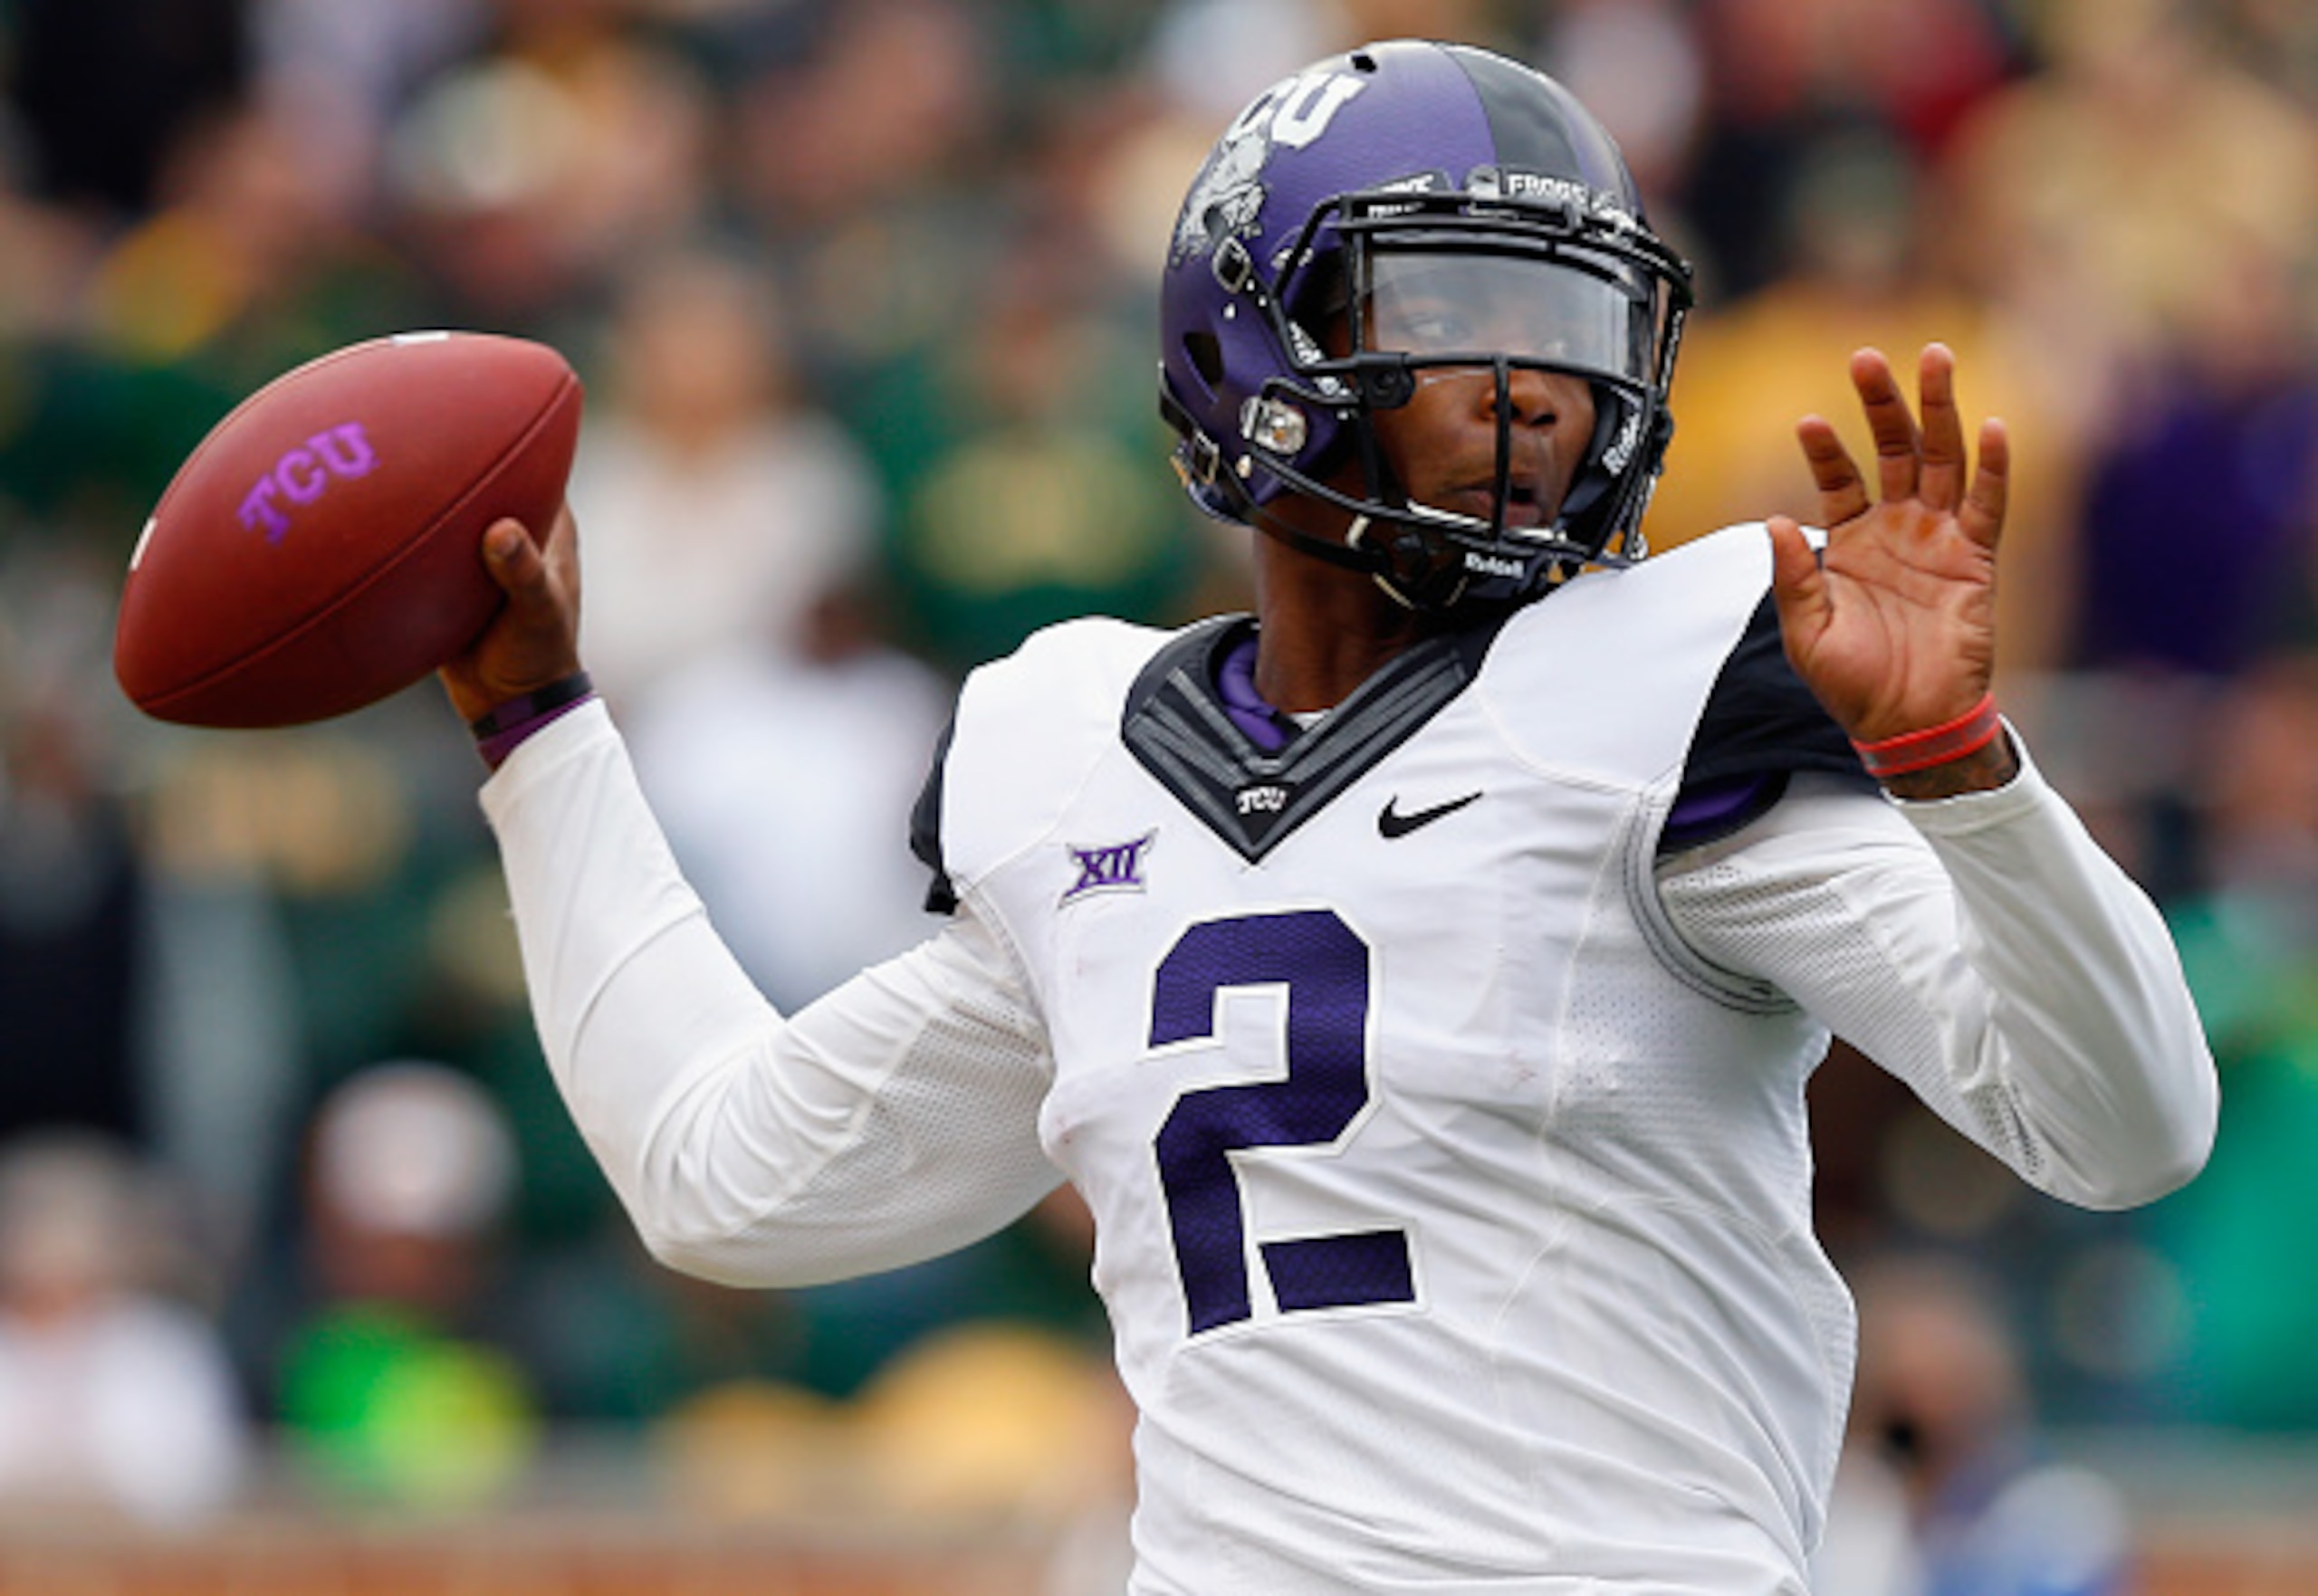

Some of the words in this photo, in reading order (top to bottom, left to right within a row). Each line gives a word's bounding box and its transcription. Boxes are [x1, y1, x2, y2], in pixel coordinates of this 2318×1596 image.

[237, 421, 380, 546] TCU
[1235, 785, 1287, 814] TCU
[1060, 831, 1152, 903] XII
[1145, 907, 1422, 1338] 2
